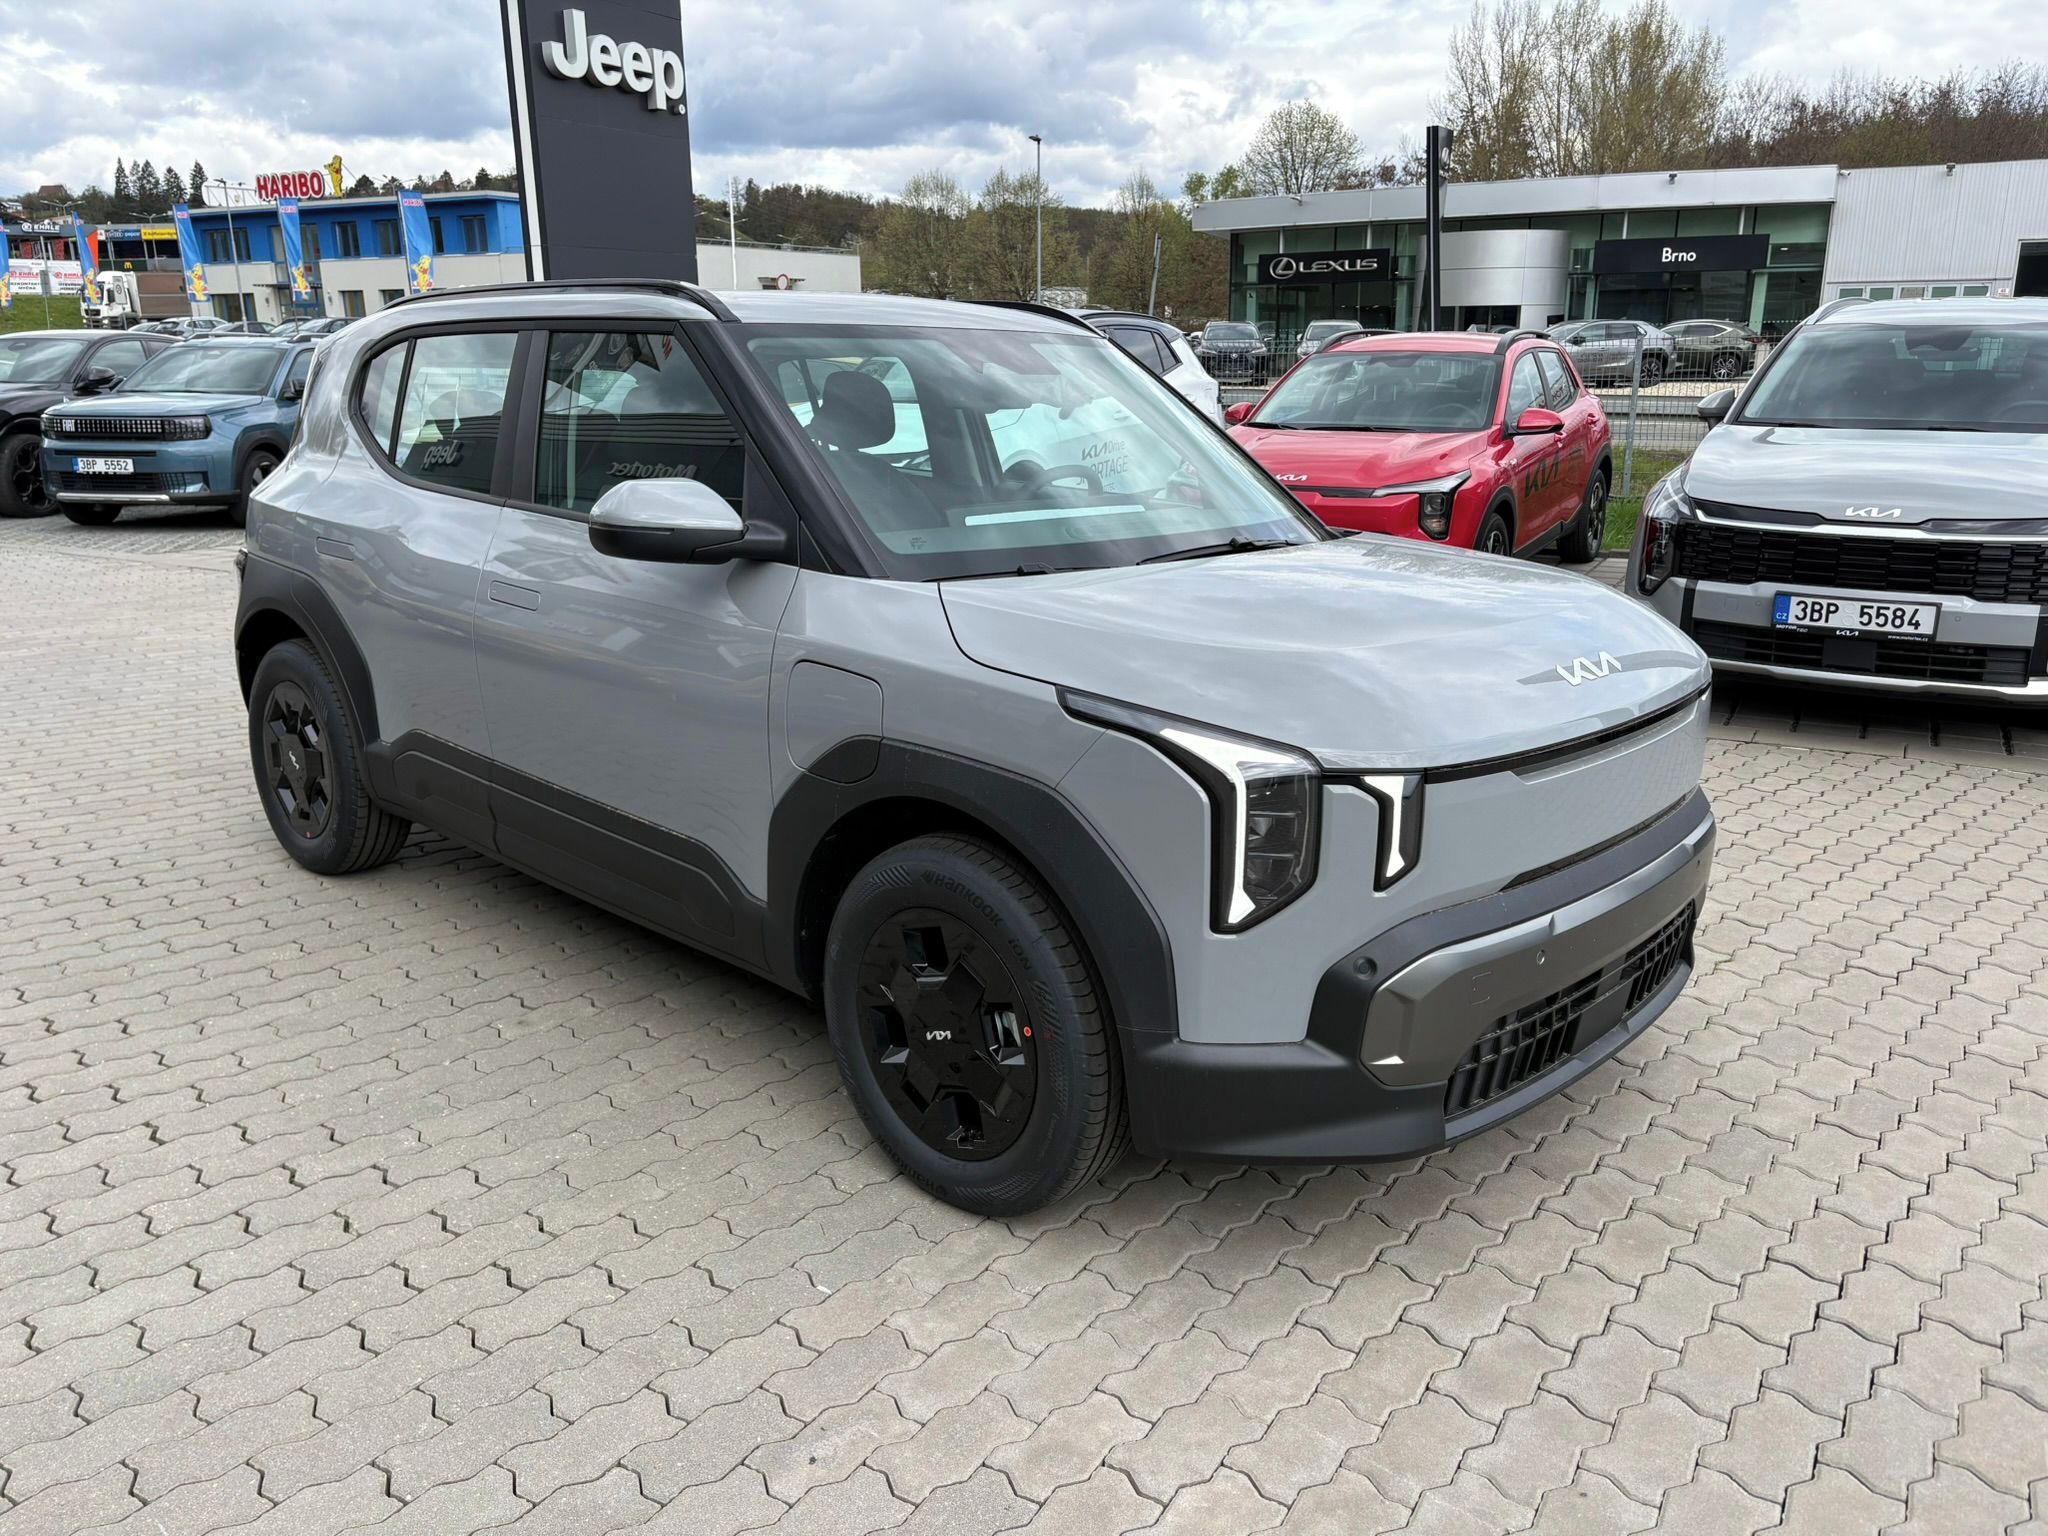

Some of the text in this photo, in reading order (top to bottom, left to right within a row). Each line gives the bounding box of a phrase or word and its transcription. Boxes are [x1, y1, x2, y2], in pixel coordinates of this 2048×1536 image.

[542, 8, 685, 111] Jeep
[256, 171, 324, 200] HARIBO
[1662, 247, 1697, 262] Brno
[1299, 258, 1378, 273] LEXUS
[62, 419, 76, 432] FIAT
[80, 459, 130, 471] 3BP 5552
[1844, 506, 1902, 518] KIA
[1776, 612, 1788, 620] CZ
[1794, 600, 1922, 631] 3BP 5584
[1836, 629, 1859, 637] KIA
[1556, 651, 1622, 686] KIA
